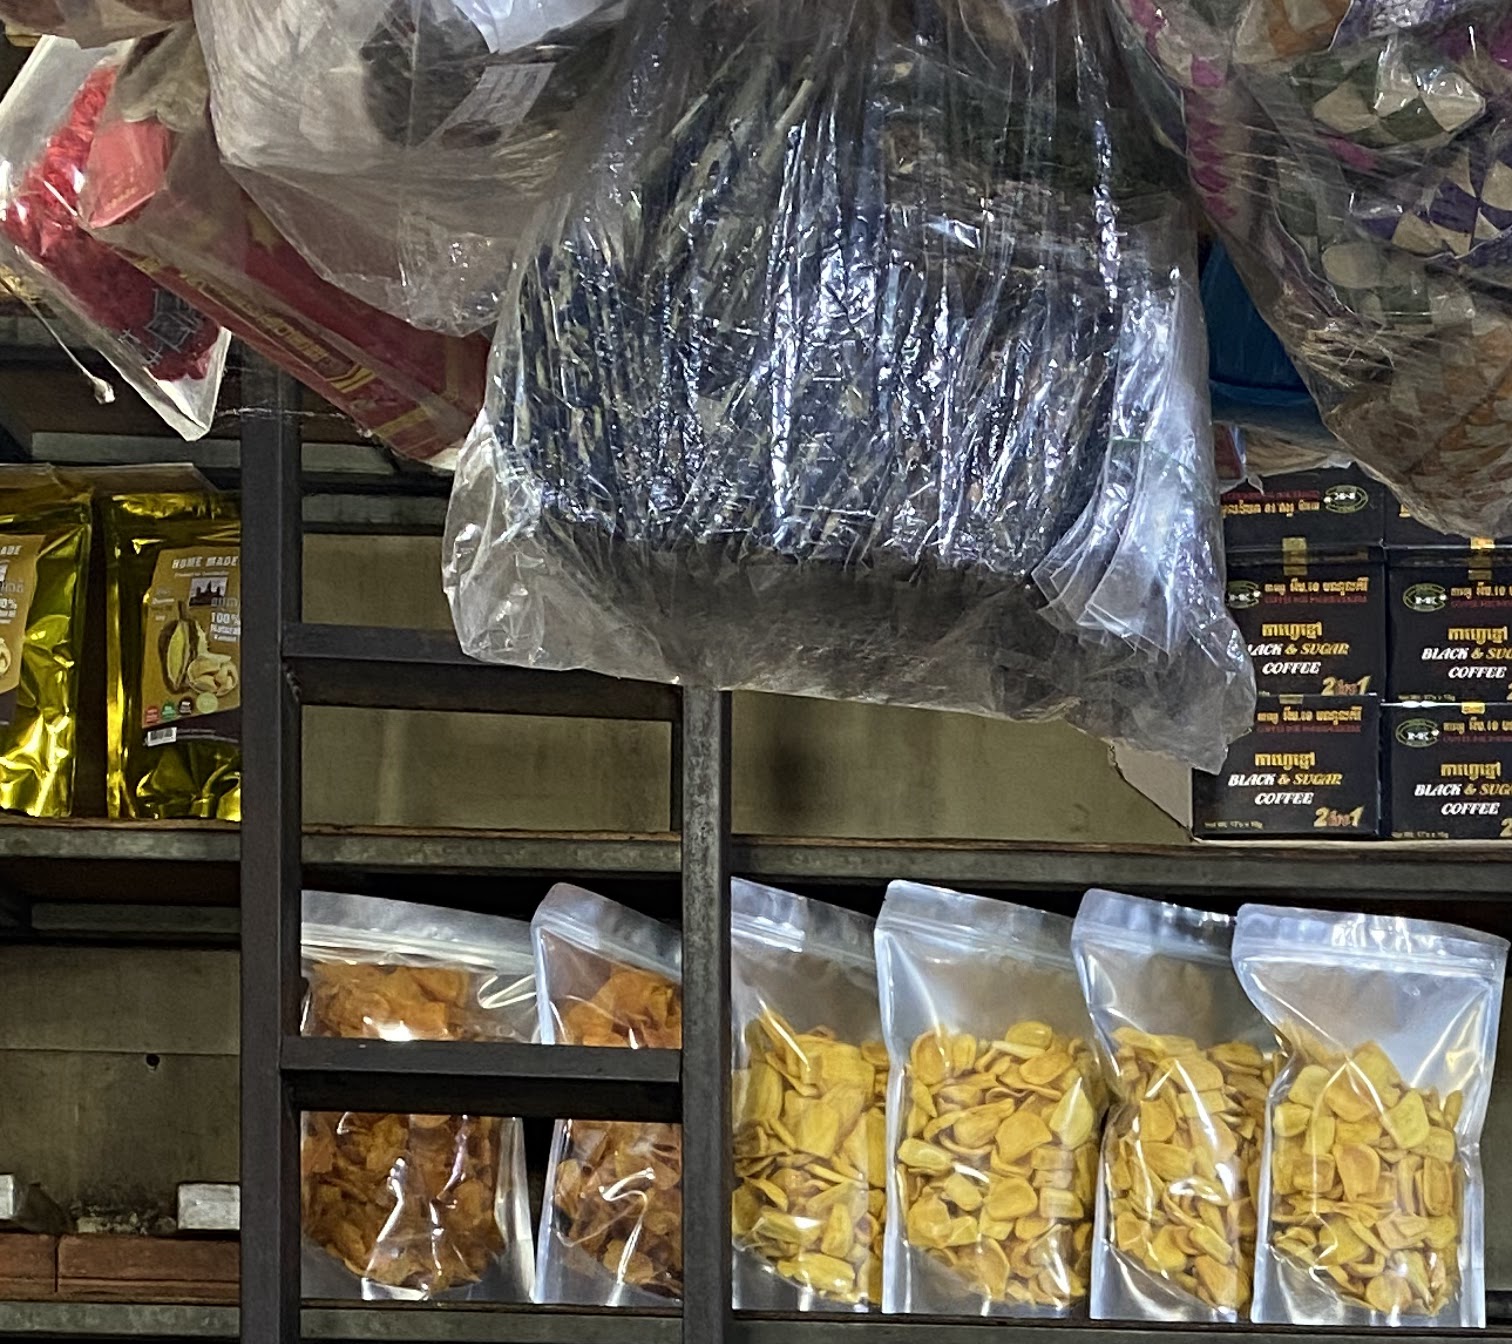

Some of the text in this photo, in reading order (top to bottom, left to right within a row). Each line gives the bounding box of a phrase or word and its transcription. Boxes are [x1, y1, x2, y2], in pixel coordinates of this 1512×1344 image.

[0, 545, 22, 555] ADE
[1247, 643, 1351, 656] LACK & SUGAR
[1422, 648, 1470, 660] BLACK
[1471, 648, 1484, 660] &
[1262, 661, 1321, 675] COFFEE
[1448, 666, 1507, 679] COFFEE
[1228, 773, 1343, 786] BLACK & SUGAR
[1414, 784, 1462, 796] BLACK
[1464, 784, 1476, 795] &
[1255, 792, 1314, 805] COFFEE
[1441, 802, 1500, 815] COFFEE
